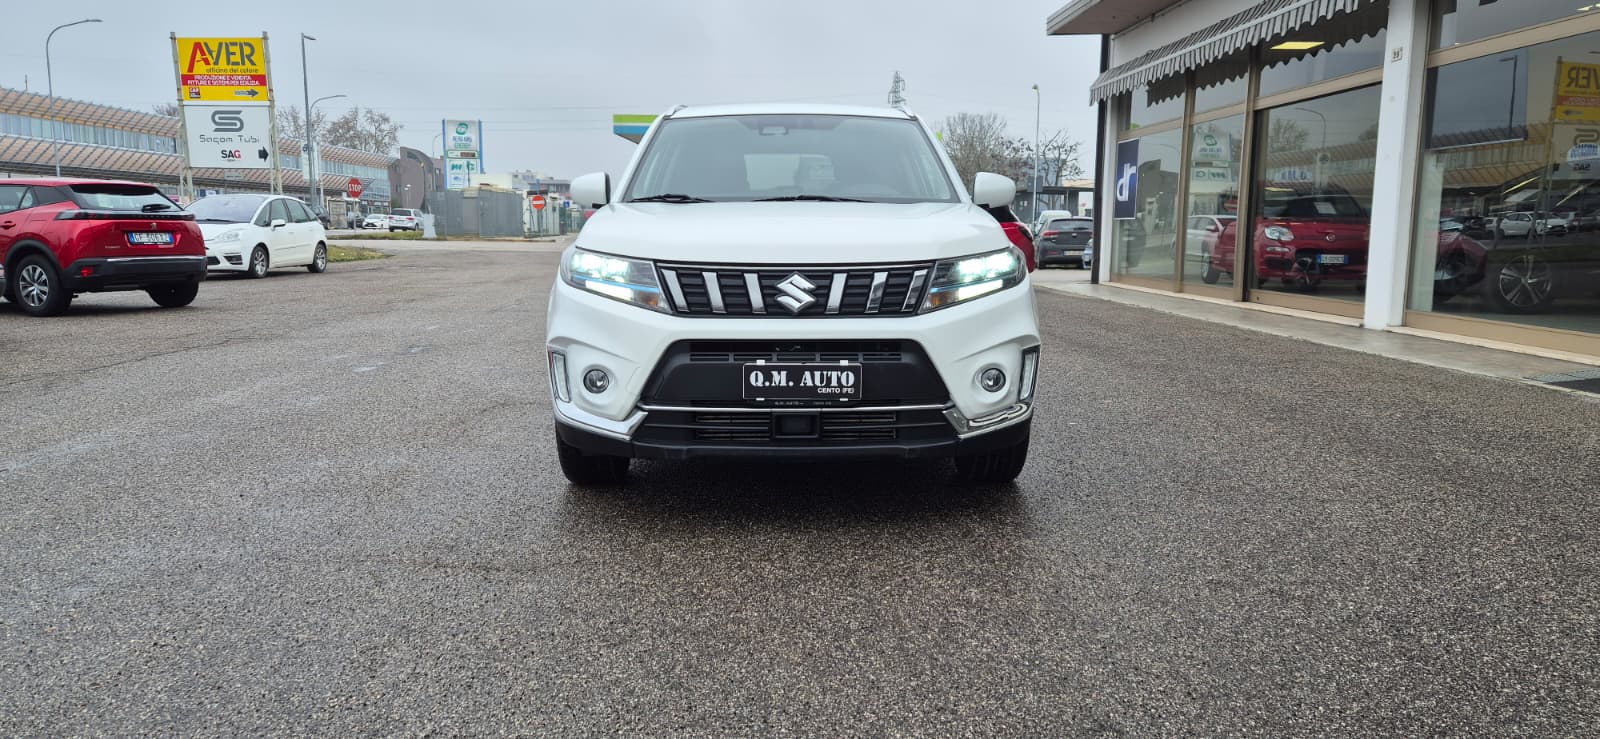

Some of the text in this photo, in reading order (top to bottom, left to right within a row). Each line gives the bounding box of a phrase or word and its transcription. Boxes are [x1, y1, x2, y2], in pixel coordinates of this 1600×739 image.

[187, 41, 257, 73] AVER
[238, 134, 260, 143] Tubi
[221, 149, 241, 158] SAG
[348, 183, 362, 192] STOP
[1117, 163, 1137, 201] dr
[749, 370, 855, 387] Q.M. AUTO
